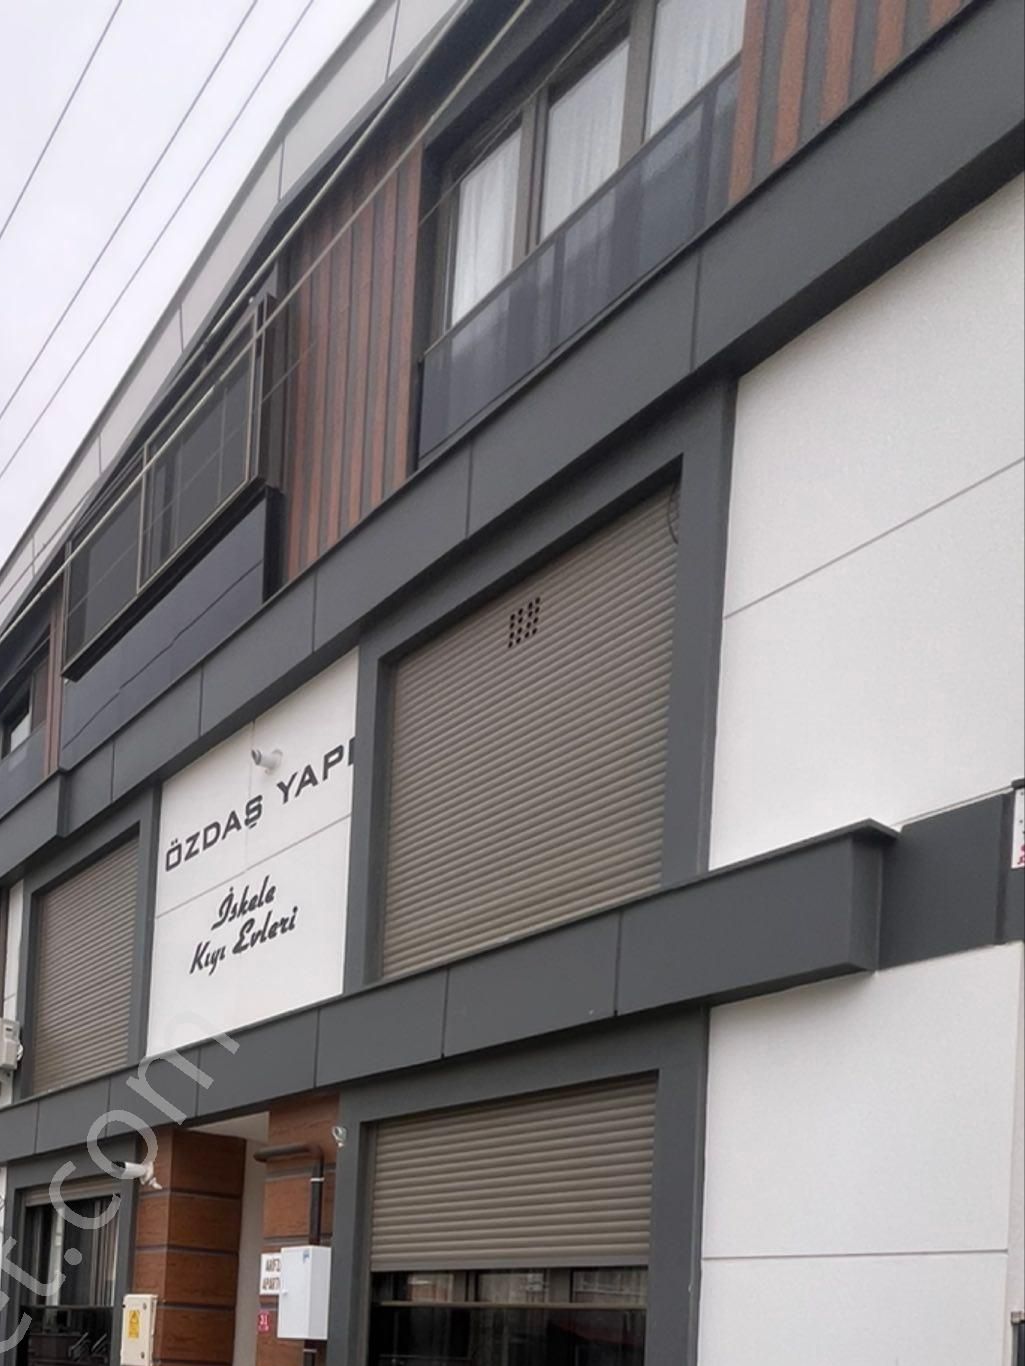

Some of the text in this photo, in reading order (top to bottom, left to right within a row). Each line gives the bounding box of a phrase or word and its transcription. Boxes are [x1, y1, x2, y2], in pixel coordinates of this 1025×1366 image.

[165, 794, 263, 872] ÖZDAŞ
[211, 875, 276, 931] İskele
[232, 905, 298, 954] Evleri
